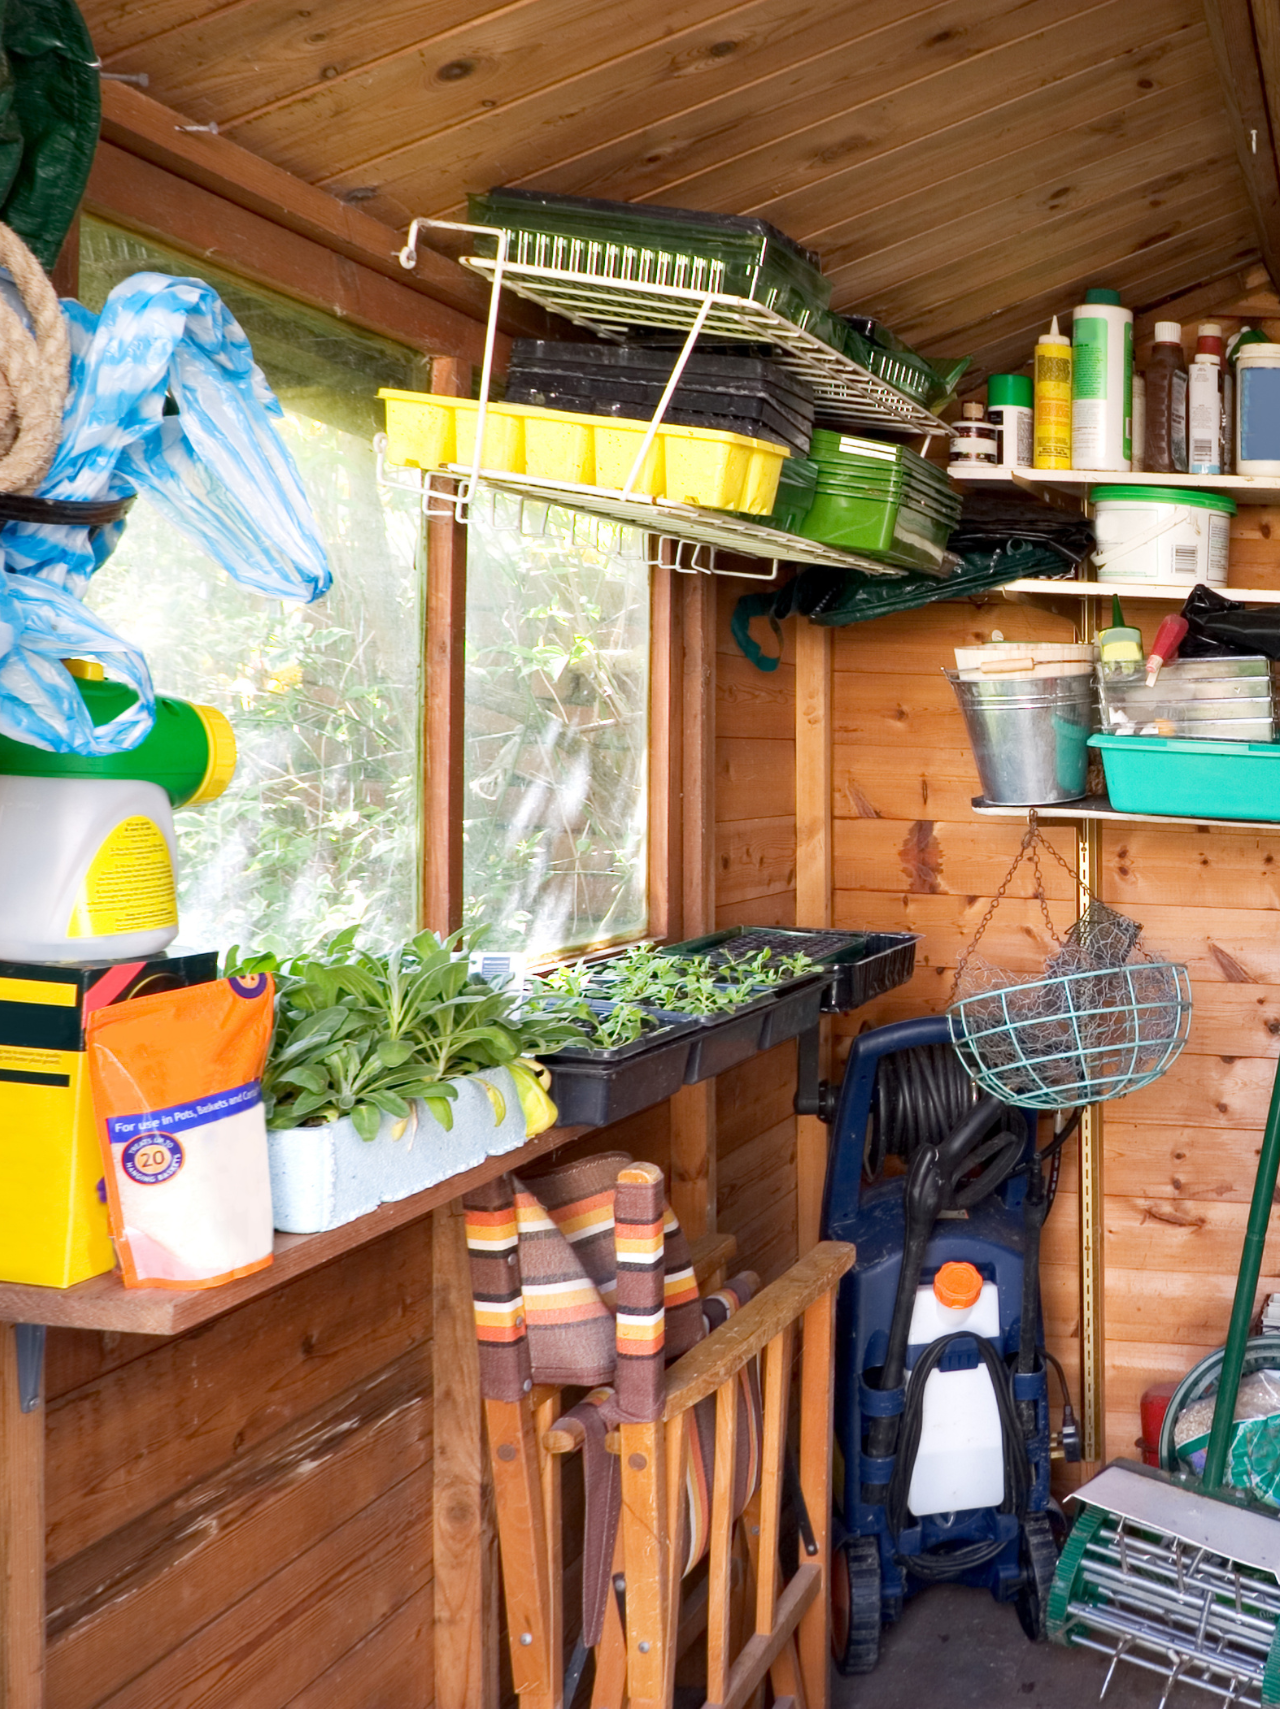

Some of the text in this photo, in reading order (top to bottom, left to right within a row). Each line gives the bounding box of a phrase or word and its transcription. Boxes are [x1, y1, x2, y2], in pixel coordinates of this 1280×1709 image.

[114, 1122, 135, 1133] For
[138, 1119, 160, 1130] use
[161, 1115, 173, 1126] in
[173, 1110, 198, 1122] Pots,
[196, 1100, 228, 1115] Baskets
[228, 1092, 243, 1105] and
[128, 1137, 152, 1154] TREATS
[162, 1139, 174, 1149] TO
[125, 1153, 182, 1183] HANGING BASKETS
[140, 1150, 165, 1168] 20
